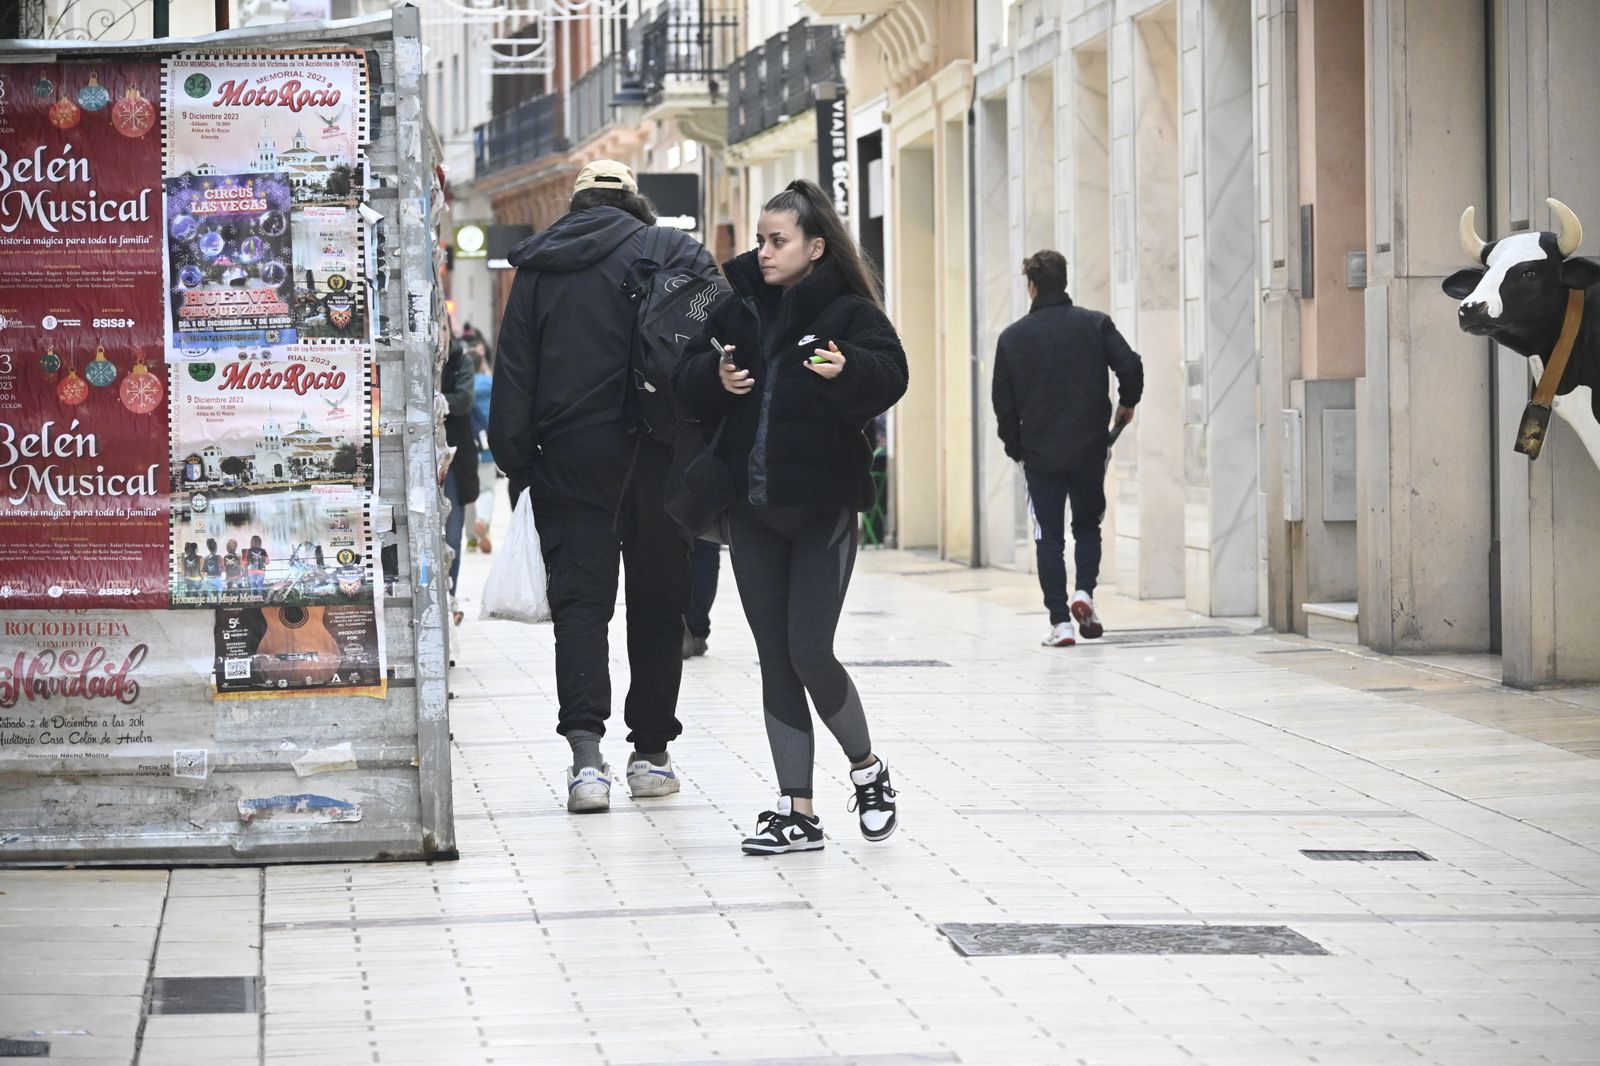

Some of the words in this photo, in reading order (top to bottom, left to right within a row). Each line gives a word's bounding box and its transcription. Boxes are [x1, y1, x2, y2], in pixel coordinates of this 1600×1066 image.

[186, 77, 207, 91] 34
[256, 71, 304, 85] MEMORIAL
[307, 71, 327, 83] 2023
[213, 79, 342, 113] MotoRocio
[182, 112, 187, 120] 9
[189, 112, 222, 120] Diciembre
[829, 100, 846, 158] VIAJES
[204, 188, 254, 200] CIRCUS
[1, 188, 152, 233] Musical
[191, 202, 218, 213] LAS
[220, 199, 267, 212] VEGAS
[33, 235, 63, 247] mágica
[65, 237, 86, 247] para
[88, 235, 107, 244] toda
[108, 235, 117, 244] la
[185, 289, 278, 306] HUELVA
[181, 305, 238, 318] PARQUE
[93, 319, 125, 327] asisa
[207, 319, 242, 327] DICIEMBRE
[311, 356, 331, 366] 2023
[218, 362, 346, 395] MotoRocio
[187, 394, 192, 403] 9
[9, 464, 159, 505] Musical
[5, 508, 38, 516] historia
[40, 508, 71, 520] mágica
[73, 509, 93, 520] para
[95, 508, 114, 517] toda
[116, 508, 125, 517] la
[172, 593, 204, 606] Homenaje
[218, 592, 239, 605] Mujer
[5, 622, 60, 636] ROCIO
[37, 640, 89, 648] CONCIERTO
[0, 643, 149, 709] Navidad
[30, 719, 36, 728] 2
[40, 716, 49, 728] de
[51, 715, 98, 729] Diciembre
[112, 714, 125, 728] las
[129, 715, 145, 727] 20h
[40, 731, 64, 745] Casa
[69, 730, 97, 745] Colón
[100, 731, 111, 744] de
[115, 730, 153, 745] Huelva
